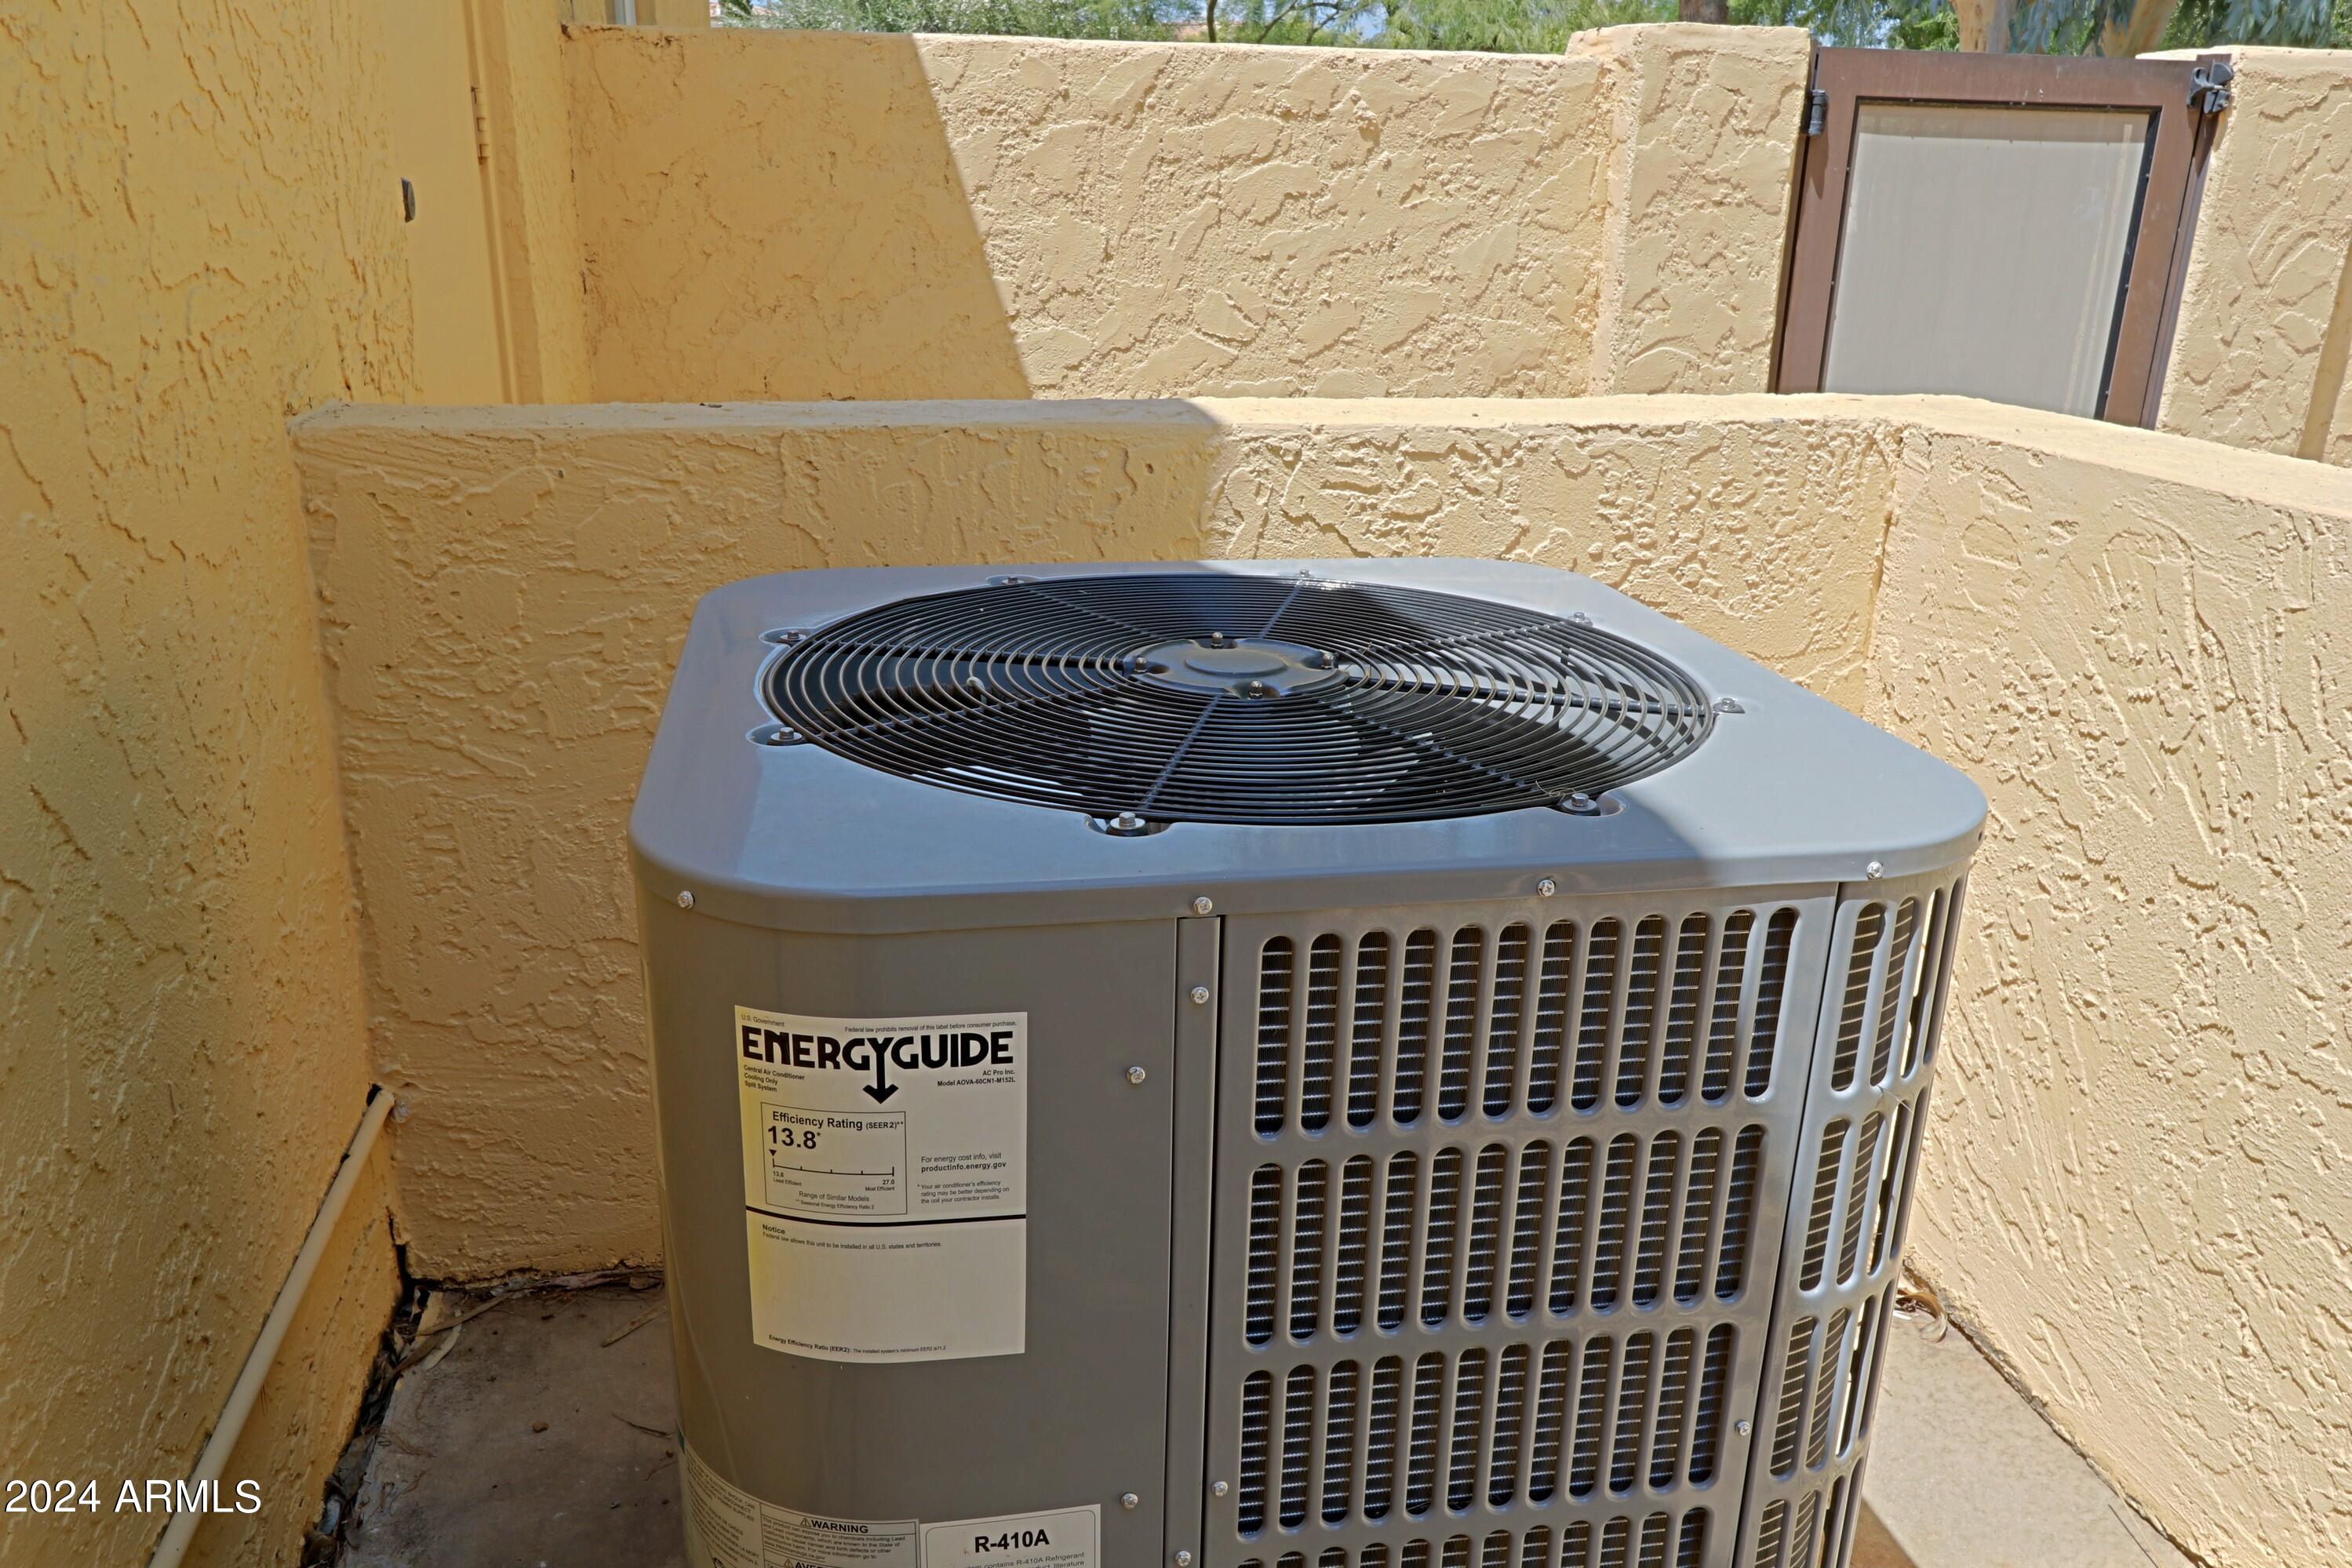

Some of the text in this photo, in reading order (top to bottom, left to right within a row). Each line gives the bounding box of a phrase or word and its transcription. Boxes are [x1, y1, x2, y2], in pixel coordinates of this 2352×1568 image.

[753, 1017, 785, 1027] Government
[742, 1025, 1014, 1070] ENERGYGUIDE
[744, 1064, 762, 1074] Central
[772, 1071, 805, 1080] Conditioner
[744, 1072, 778, 1086] Cooling Only
[758, 1083, 777, 1092] System
[773, 1111, 824, 1129] Efficiency
[827, 1117, 863, 1131] Rating
[921, 1162, 1007, 1173] productinfo.energy.gov
[799, 1191, 817, 1199] Range
[763, 1224, 785, 1235] Notice
[763, 1231, 780, 1240] Federal
[769, 1334, 786, 1344] Energy
[788, 1339, 813, 1349] Efficiency
[811, 1519, 868, 1533] WARNING
[974, 1529, 1050, 1553] R-410A
[1045, 1552, 1084, 1562] Refrigerant
